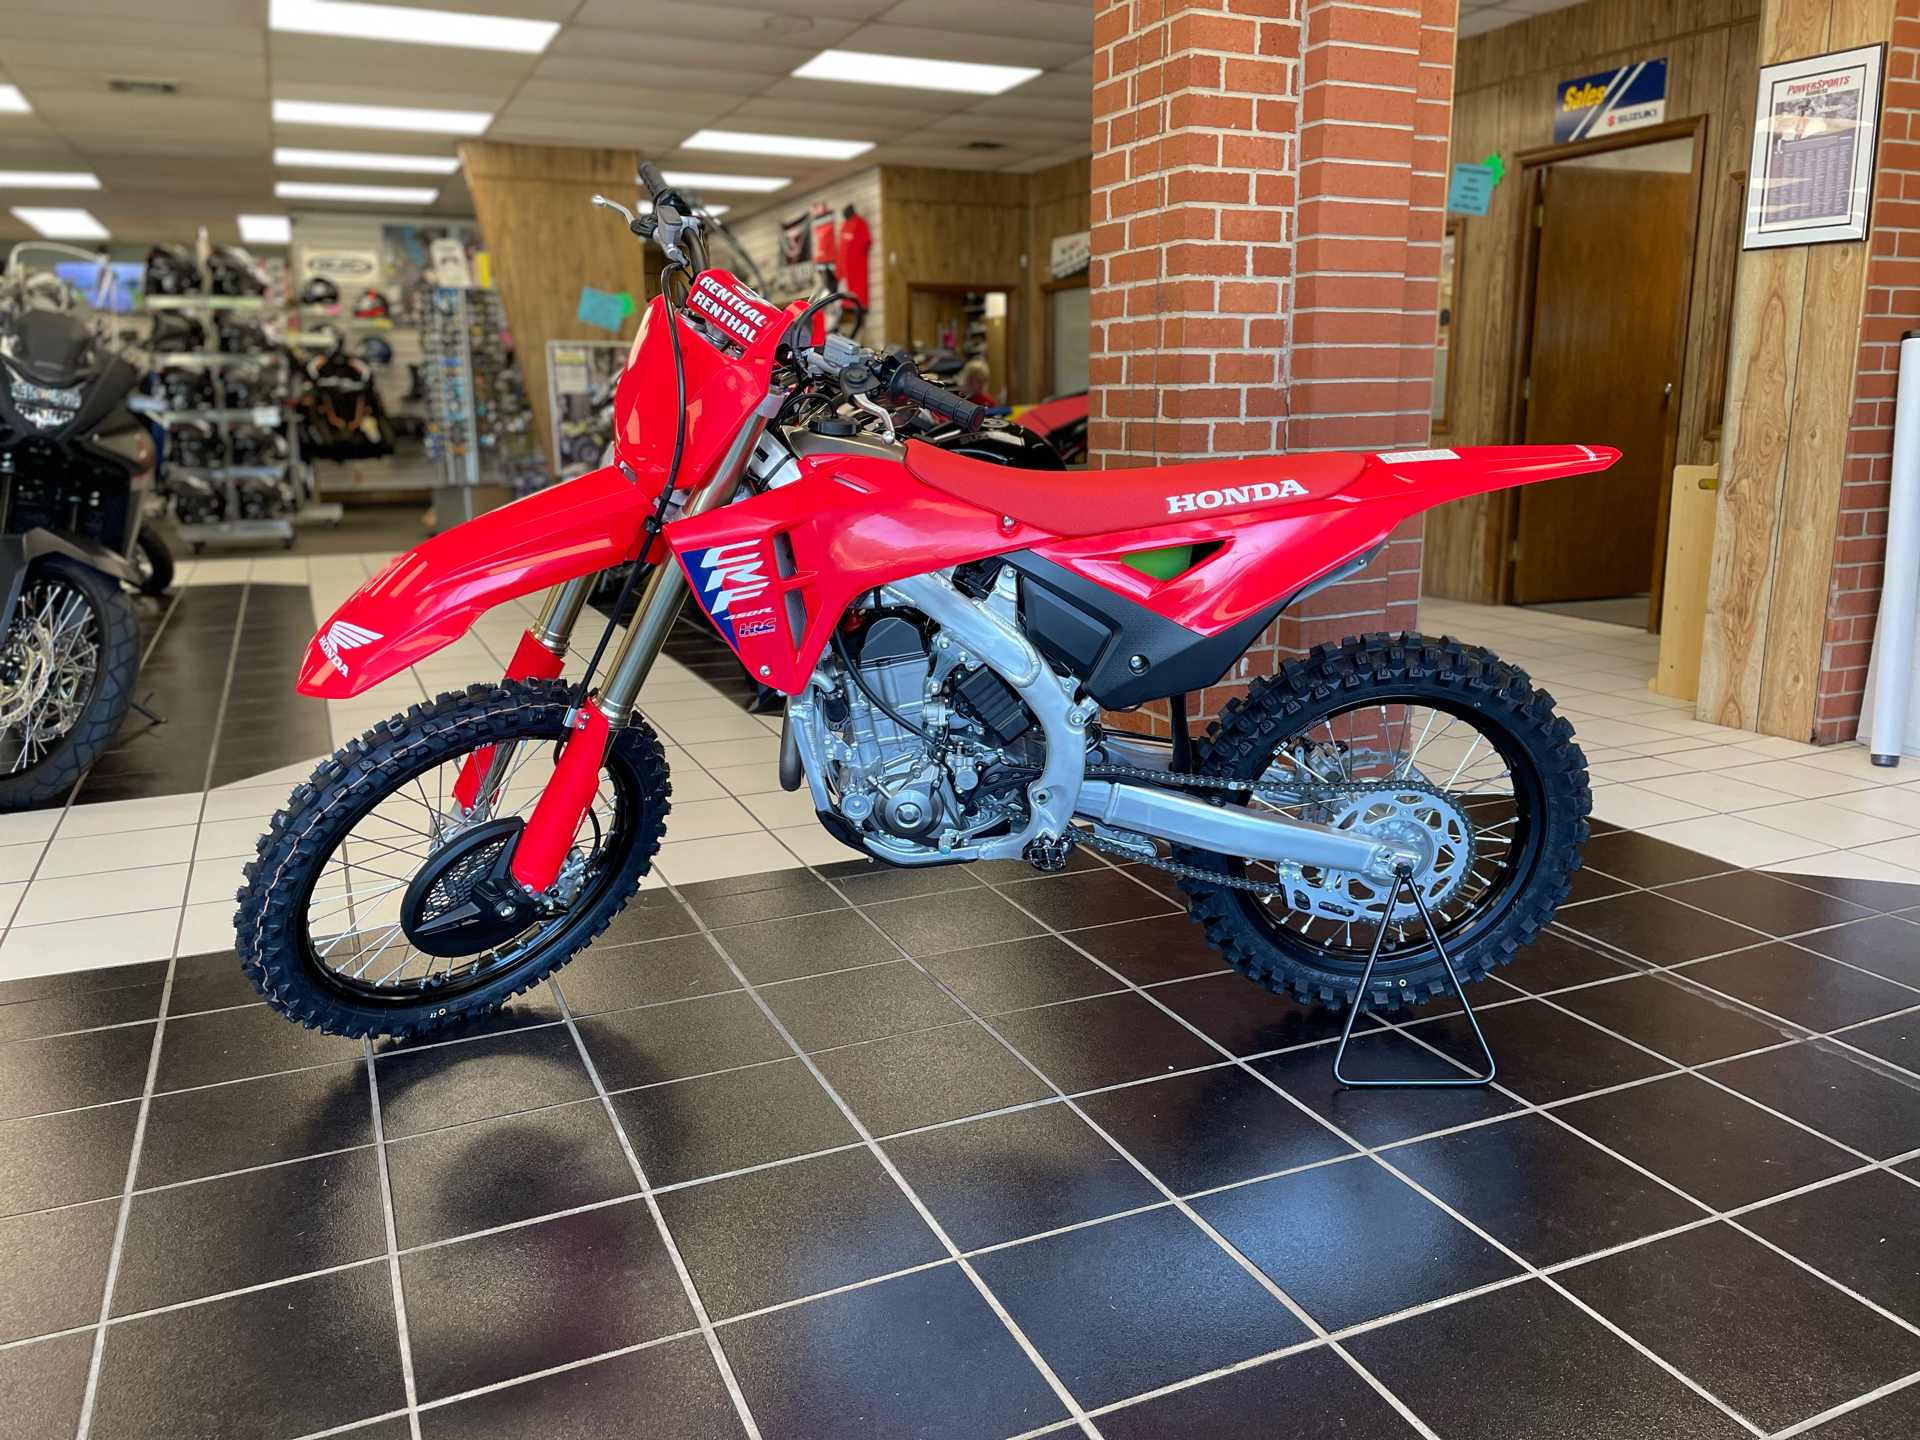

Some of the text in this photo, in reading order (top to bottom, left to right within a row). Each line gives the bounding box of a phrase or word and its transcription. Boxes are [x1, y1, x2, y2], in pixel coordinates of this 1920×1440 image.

[1562, 82, 1607, 112] Sales
[692, 290, 758, 344] RENTHAL
[699, 275, 768, 328] RENTHAL
[1165, 478, 1309, 514] HONDA
[739, 617, 777, 637] HRC
[318, 634, 349, 678] HONDA
